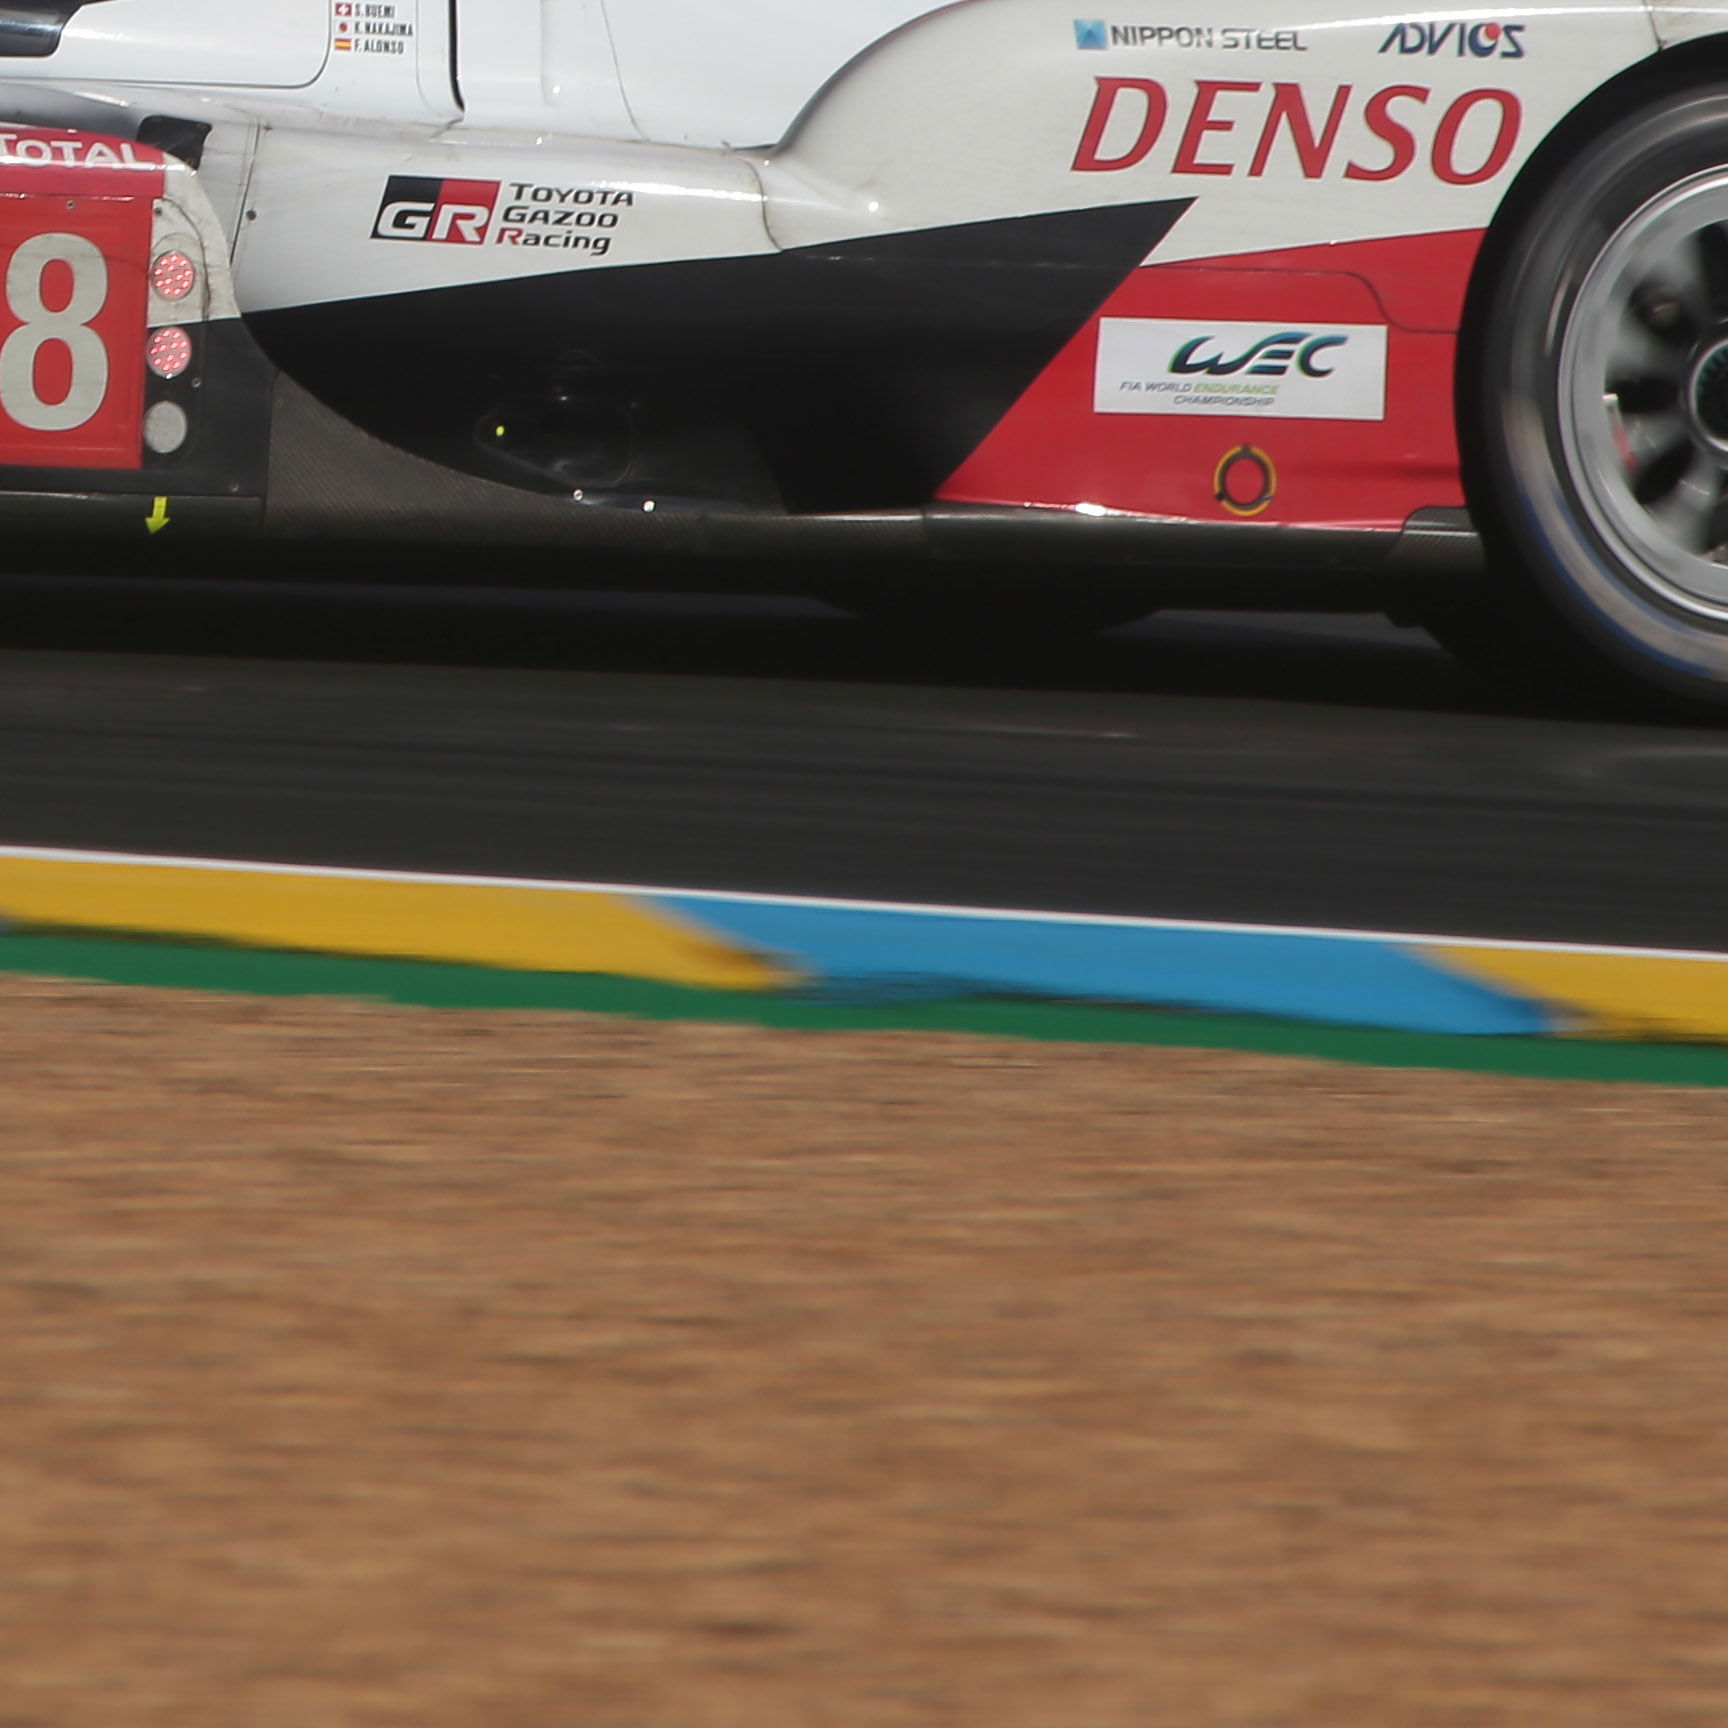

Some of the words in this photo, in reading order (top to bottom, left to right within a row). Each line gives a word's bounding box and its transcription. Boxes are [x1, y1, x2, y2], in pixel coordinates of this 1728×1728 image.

[1110, 25, 1214, 49] NIPPON
[1221, 27, 1308, 52] STEEL
[1377, 22, 1526, 59] ADVICS
[1070, 75, 1523, 186] DENSO
[508, 182, 633, 207] TOYOTA
[378, 201, 491, 242] GR
[501, 204, 620, 229] GAZOO
[494, 227, 612, 257] Racing
[1167, 331, 1350, 378] WEC
[1120, 381, 1141, 391] FIA
[1145, 381, 1192, 393] WORLD
[1193, 382, 1280, 395] ENDURANCE
[1173, 394, 1276, 407] CHAMPIONSHIP
